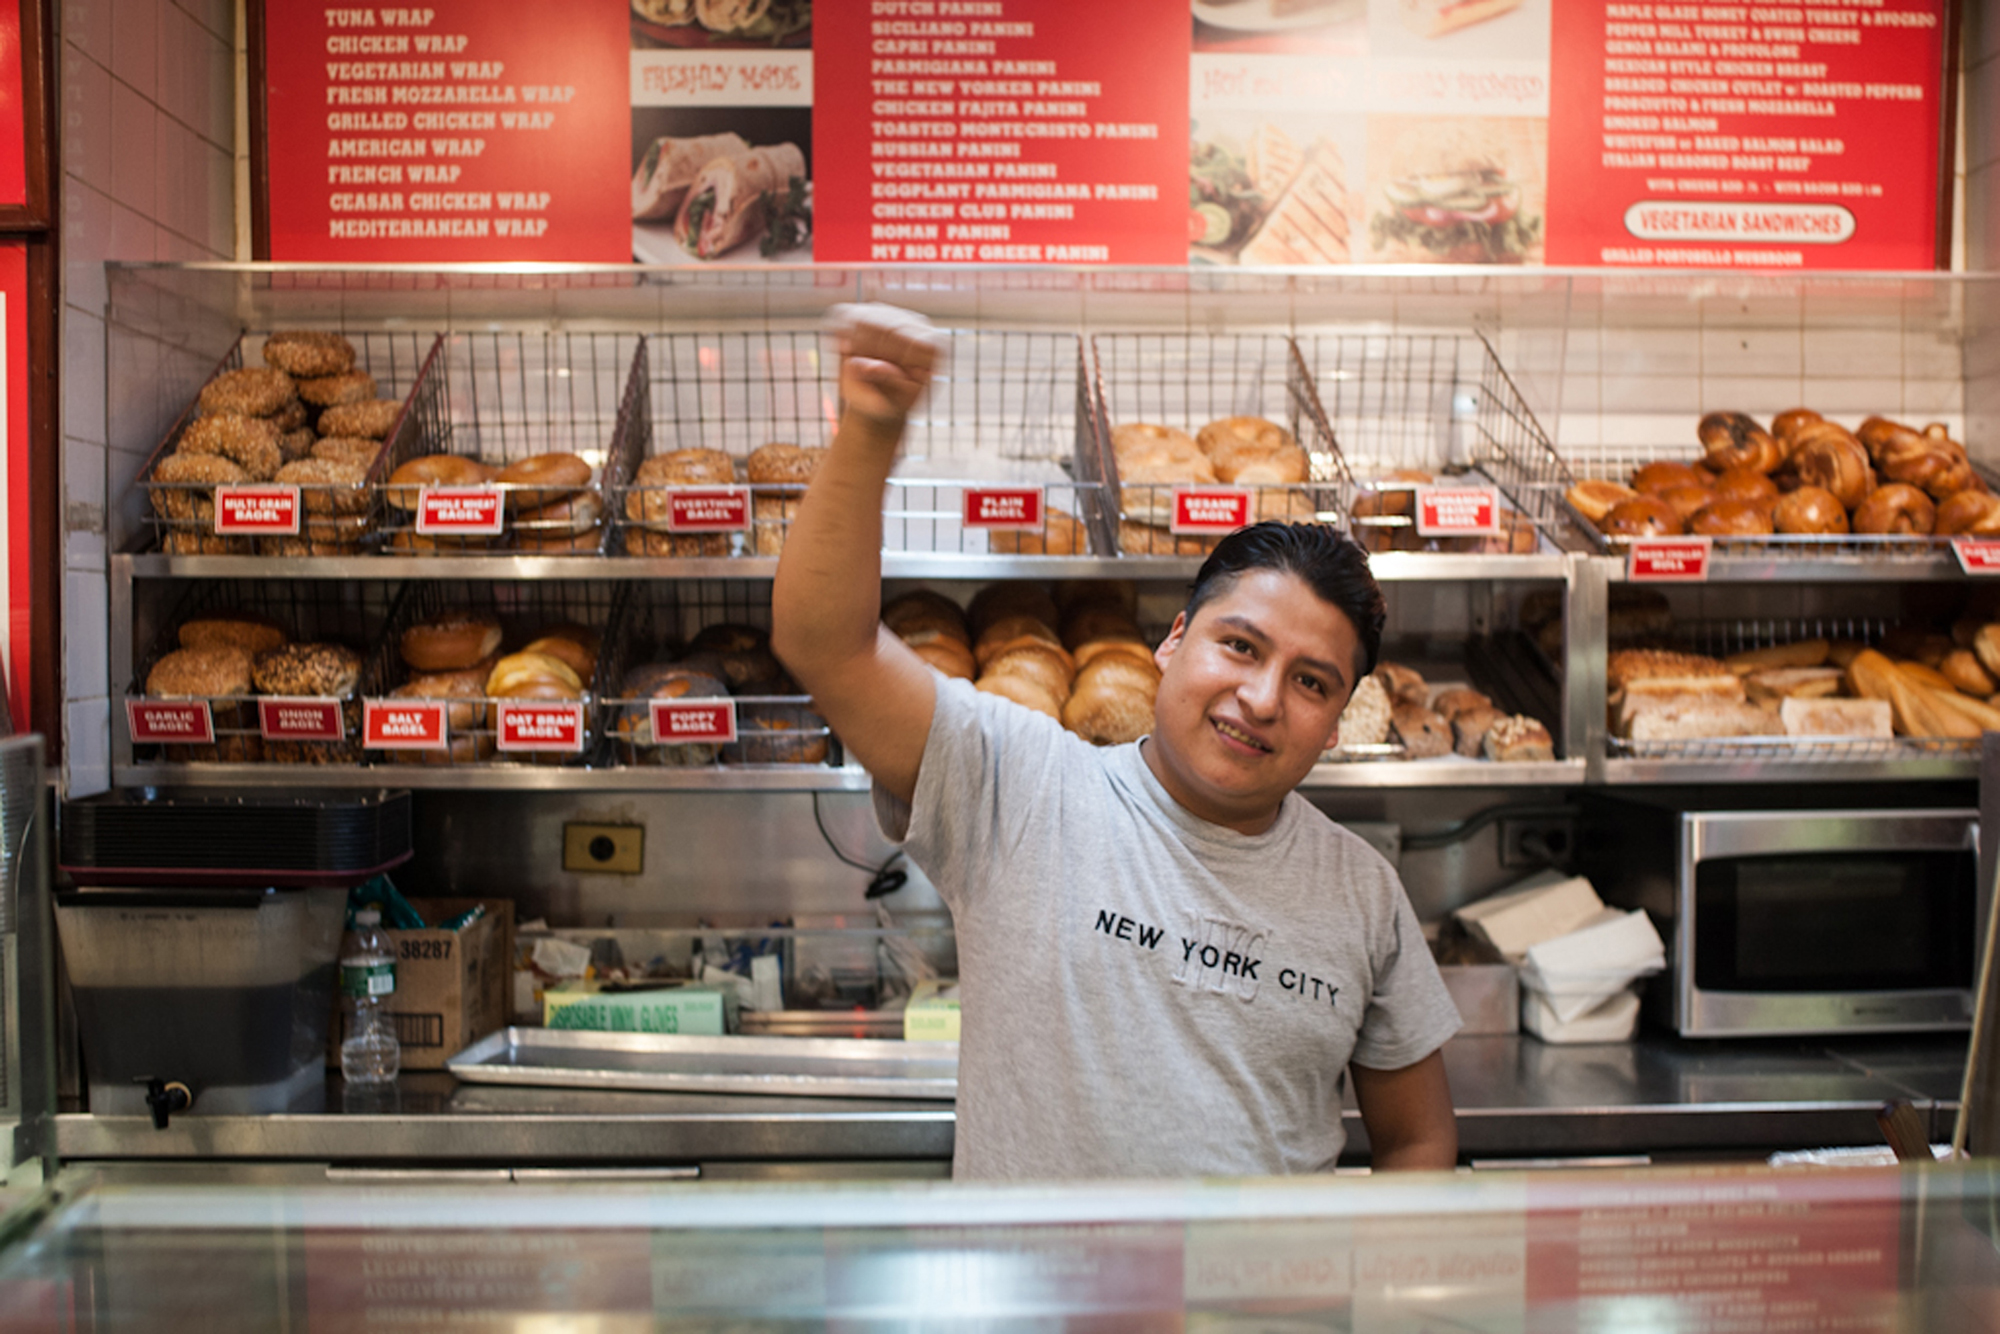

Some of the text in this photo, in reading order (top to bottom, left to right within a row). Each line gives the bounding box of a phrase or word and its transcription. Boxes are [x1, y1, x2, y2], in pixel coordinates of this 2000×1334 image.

[325, 9, 434, 26] TUNA WRAP
[326, 35, 468, 53] CHICKEN WRAP
[326, 62, 504, 79] VEGETARIAN WRAP
[327, 86, 576, 104] FRESH MOZZARELLA WRAP
[327, 112, 555, 130] GRILLED CHICKEN WRAP
[328, 139, 485, 156] AMERICAN WRAP
[328, 165, 461, 183] FRENCH WRAP
[330, 192, 550, 210] CEASAR CHICKEN WRAP
[330, 219, 548, 237] MEDITERRANEAN WRAP
[1640, 210, 1842, 234] VEGETARIAN SANDWICHES
[224, 498, 292, 510] MULTI GRAIN
[427, 498, 496, 510] WHOLE WHEAT
[674, 499, 742, 510] EVERYTHING
[983, 496, 1024, 507] PLAIN
[1185, 498, 1238, 512] SESAME
[234, 510, 280, 522] BAGEL
[438, 510, 483, 521] BAGEL
[686, 510, 732, 520] BAGEL
[980, 507, 1025, 519] BAGEL
[1189, 510, 1235, 522] BAGEL
[144, 711, 194, 722] GARLIC
[278, 709, 324, 720] ONION
[388, 713, 422, 724] SALT
[506, 714, 575, 726] OAT BRAN
[670, 712, 716, 722] POPPY
[148, 722, 194, 732] BAGEL
[280, 720, 324, 730] BAGEL
[381, 724, 427, 735] BAGEL
[671, 722, 717, 732] BAGEL
[517, 726, 563, 737] BAGEL
[400, 940, 452, 960] 38287
[1095, 910, 1339, 1006] NEW YORK CITY
